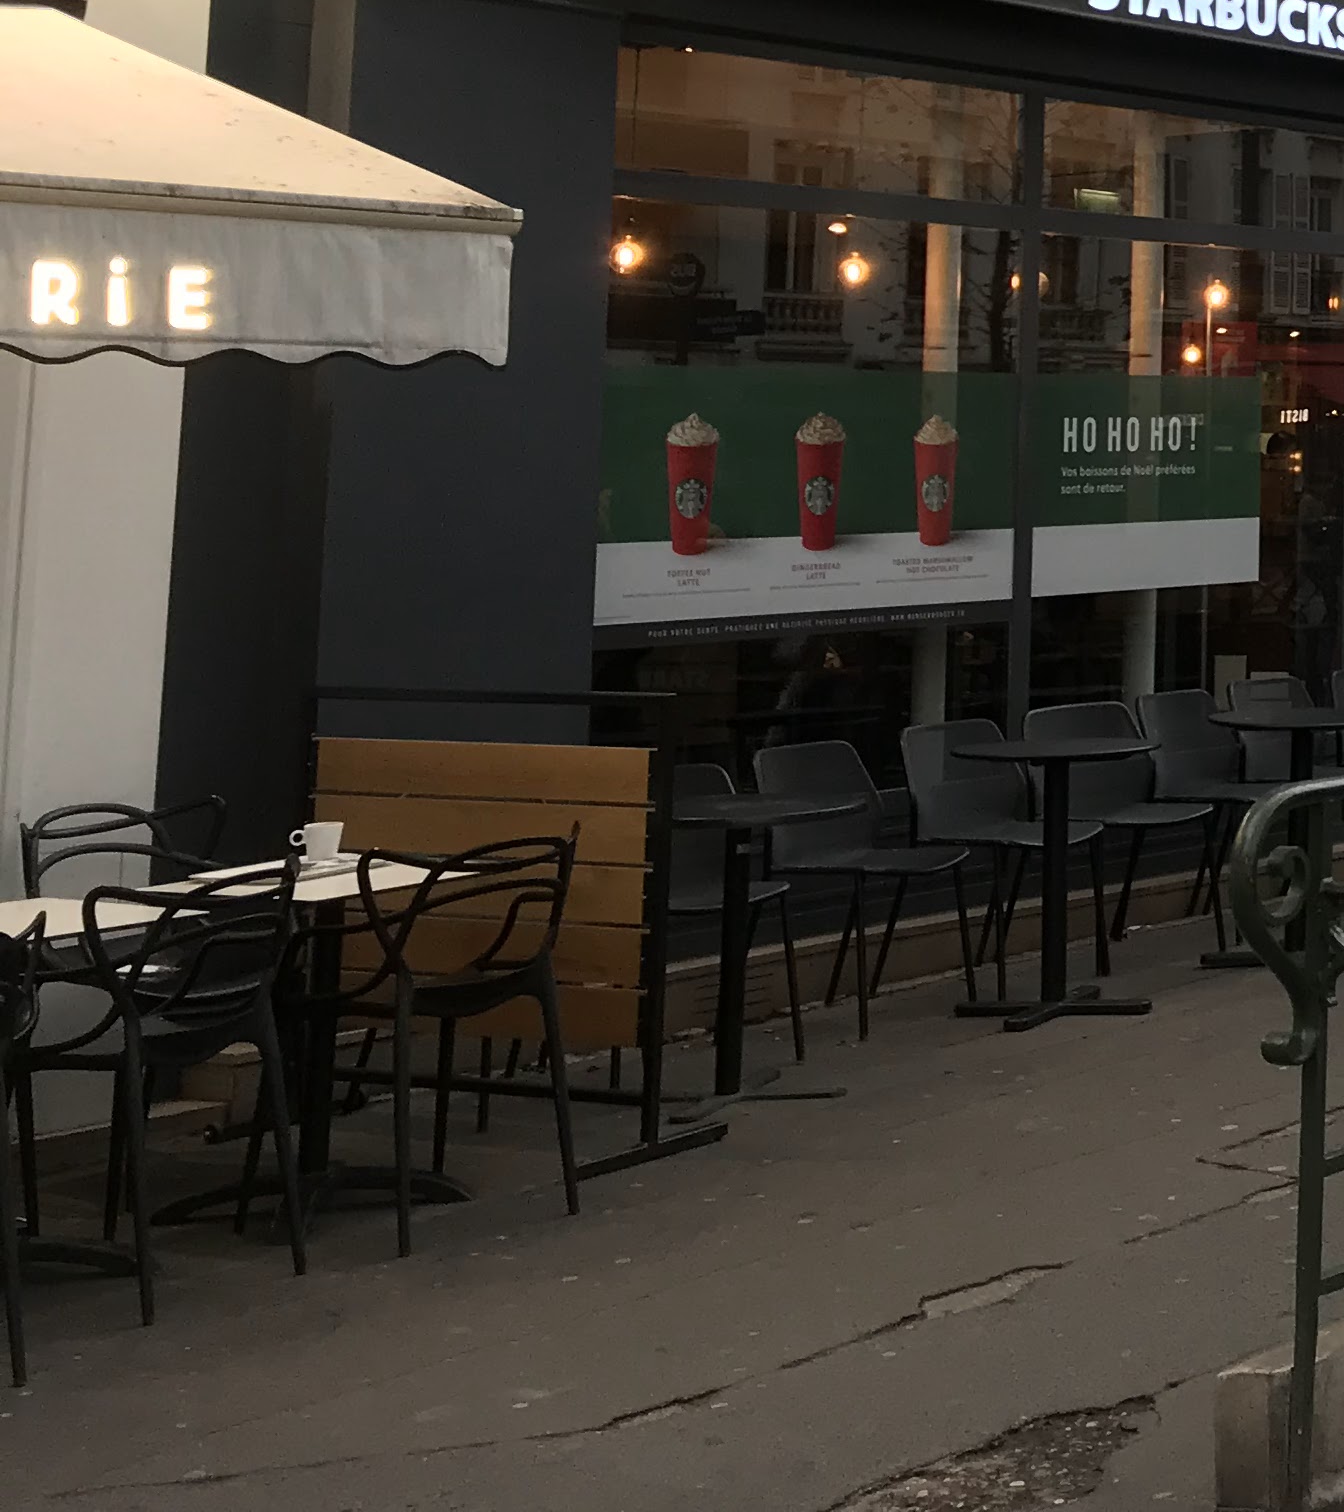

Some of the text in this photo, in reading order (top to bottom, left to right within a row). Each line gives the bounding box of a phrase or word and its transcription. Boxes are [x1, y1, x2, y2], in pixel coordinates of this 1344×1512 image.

[1063, 416, 1097, 453] HO
[1107, 416, 1140, 453] HO
[1079, 465, 1118, 477] boissons
[1120, 464, 1131, 476] de
[1133, 464, 1153, 476] Noël
[1155, 464, 1196, 477] préférées
[1060, 483, 1081, 494] sont
[1083, 483, 1094, 494] de
